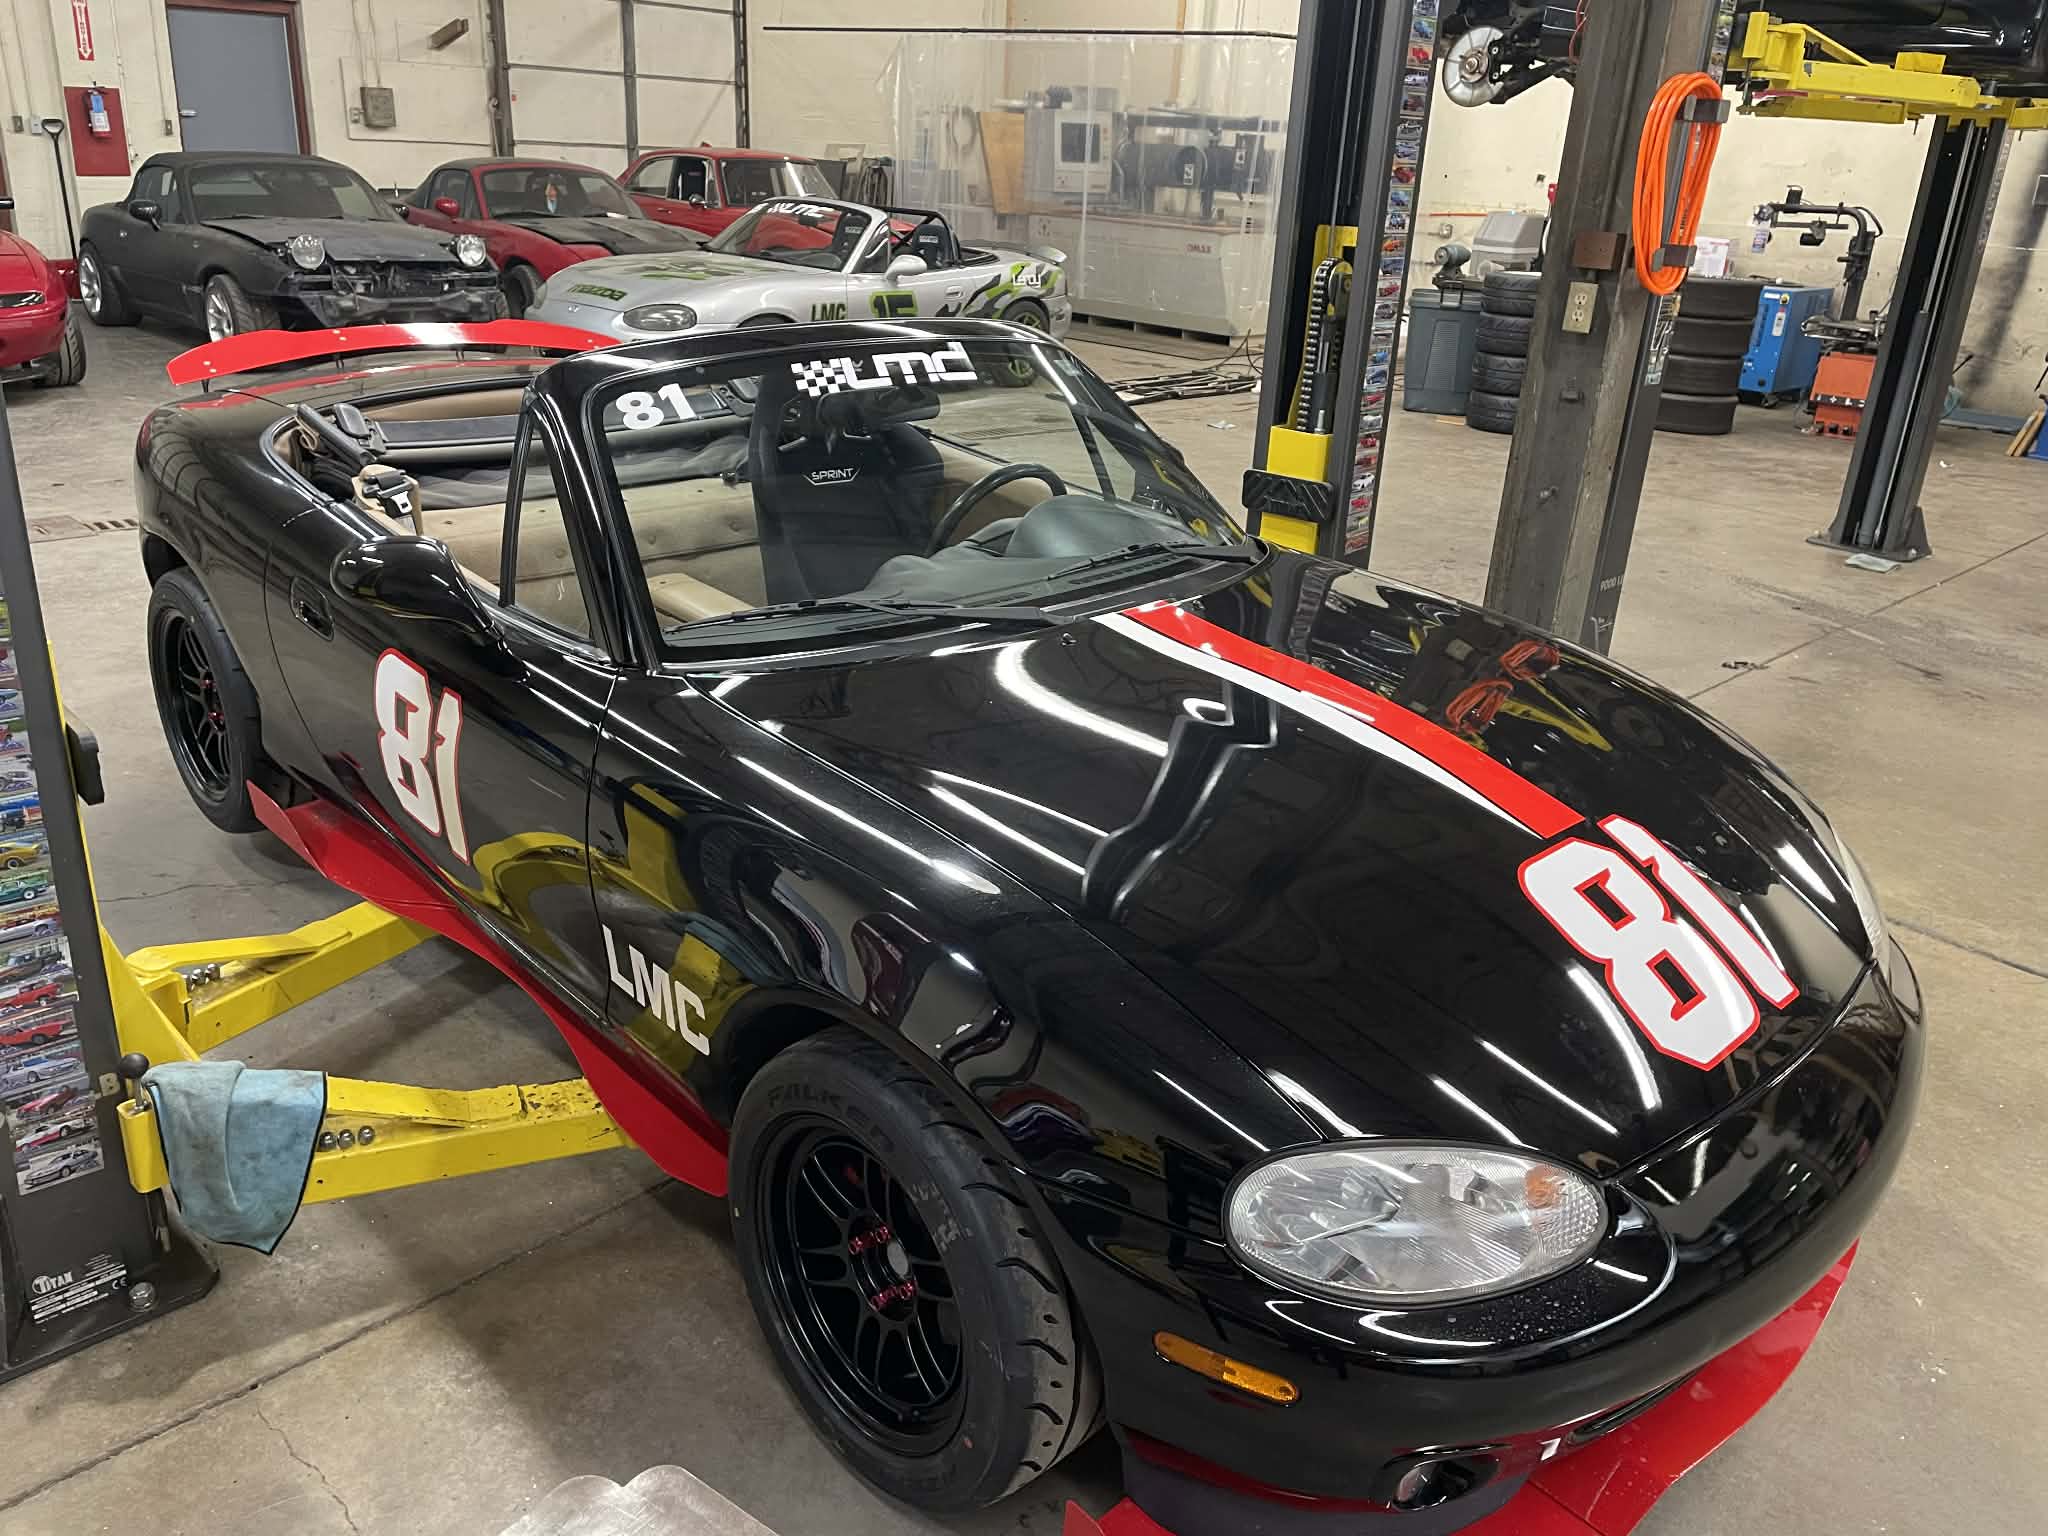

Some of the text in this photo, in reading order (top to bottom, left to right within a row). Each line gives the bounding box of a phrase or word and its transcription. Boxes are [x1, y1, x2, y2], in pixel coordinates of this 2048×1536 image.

[811, 303, 846, 321] LMC
[615, 383, 697, 430] 81
[811, 468, 854, 481] SPRINT
[375, 648, 470, 865] 81
[1517, 814, 1800, 1071] 81
[602, 924, 710, 1056] LMC
